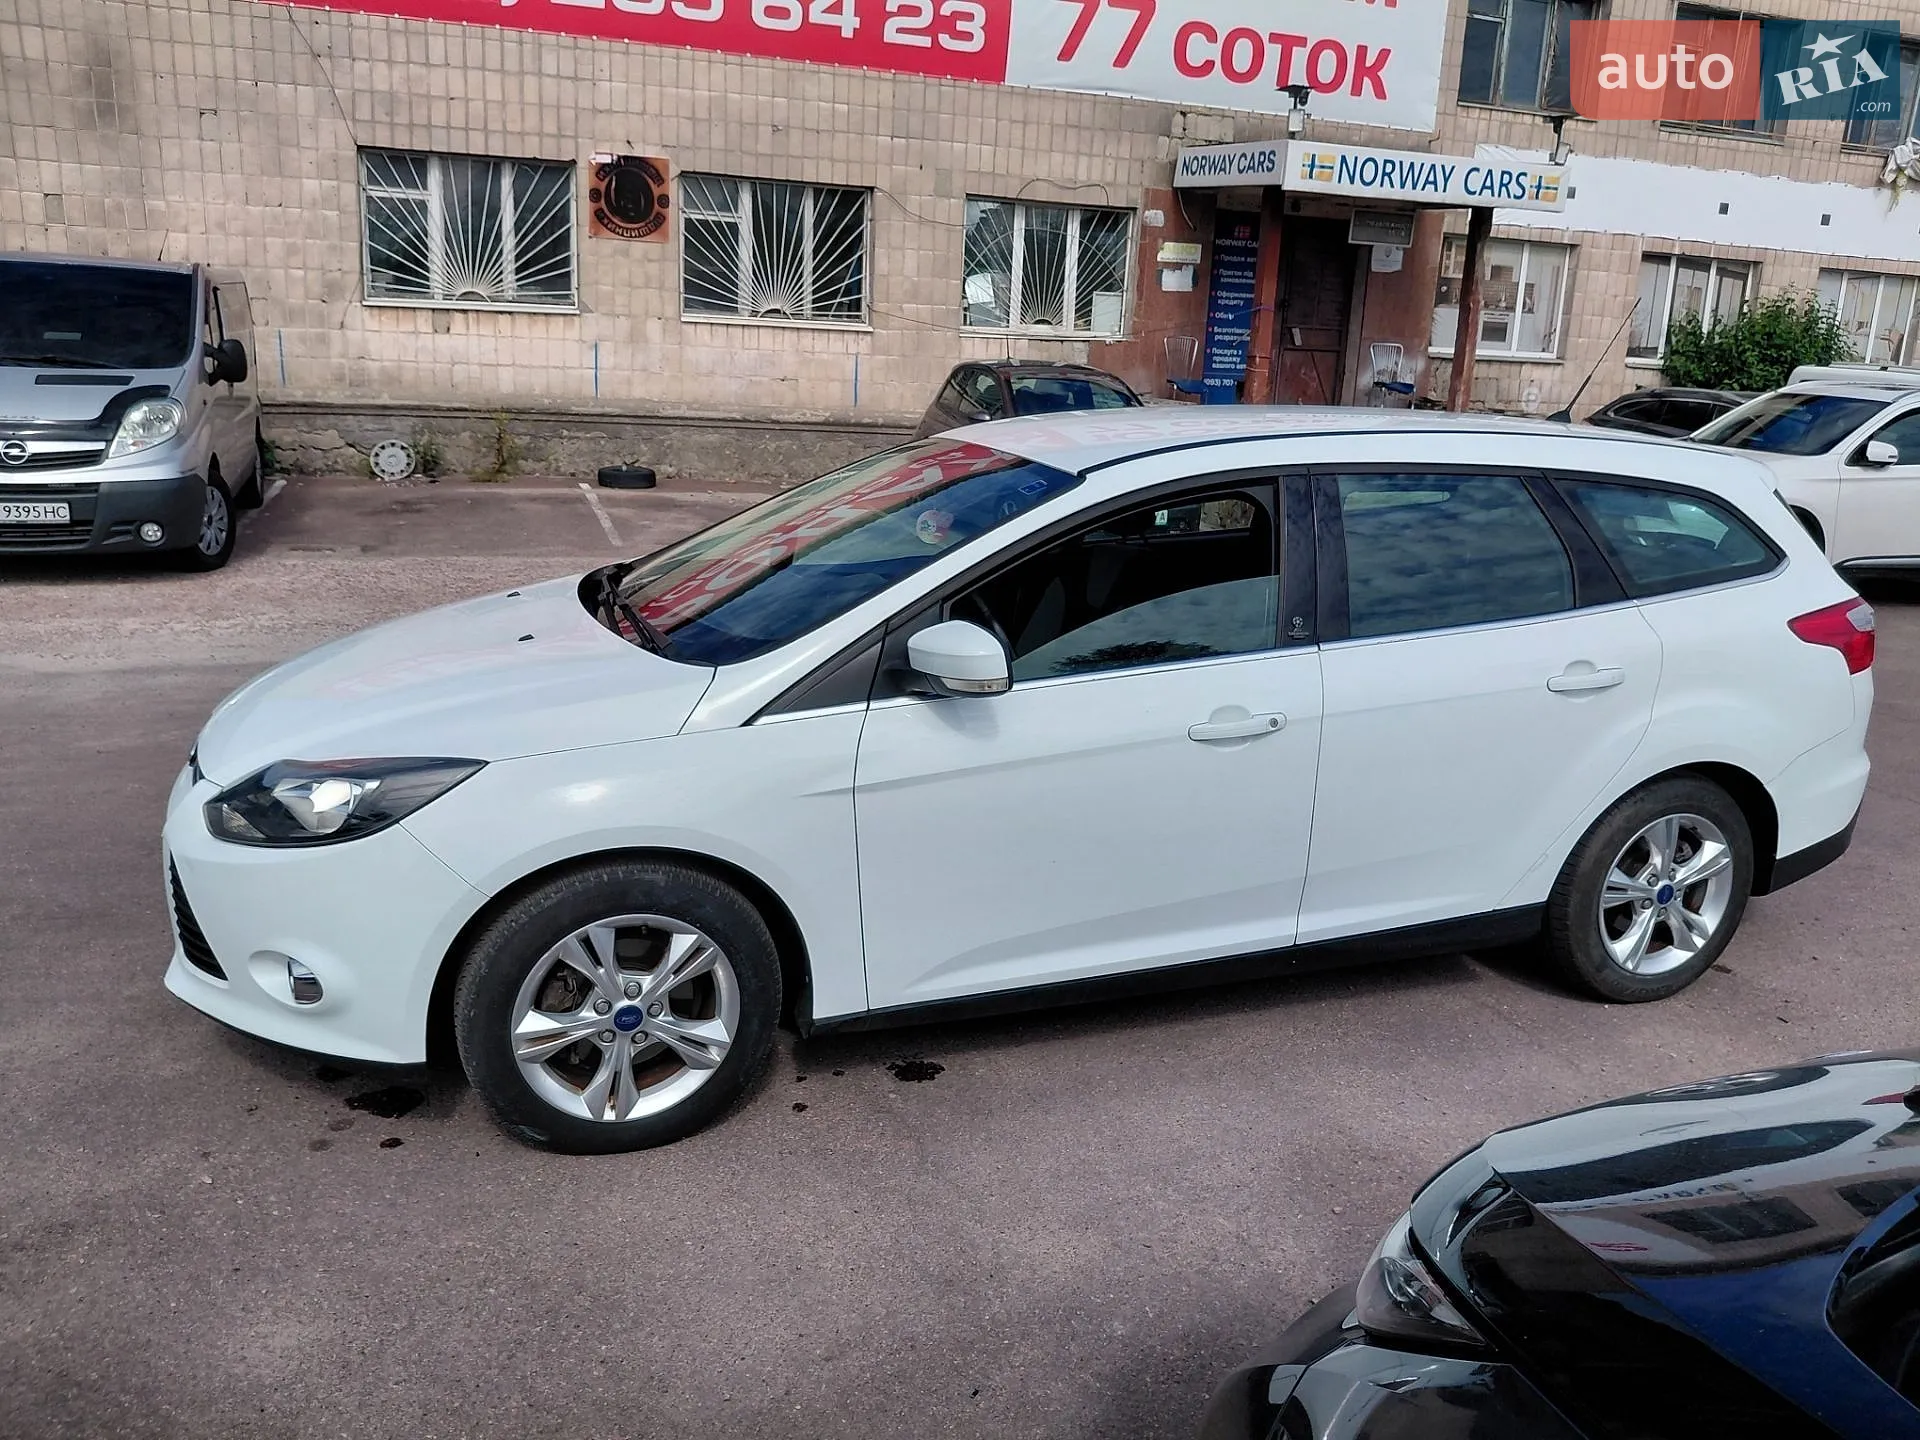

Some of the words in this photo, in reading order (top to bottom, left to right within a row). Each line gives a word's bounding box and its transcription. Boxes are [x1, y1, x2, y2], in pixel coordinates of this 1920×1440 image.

[751, 0, 860, 39] 64
[883, 0, 987, 53] 23
[1057, 0, 1157, 69] 77
[1180, 152, 1238, 176] NORWAY
[1237, 149, 1277, 173] CARS
[1336, 154, 1457, 193] NORWAY
[1462, 166, 1527, 200] CARS
[1216, 238, 1246, 247] NORWAY
[2, 505, 41, 519] 9395
[44, 505, 68, 519] HC
